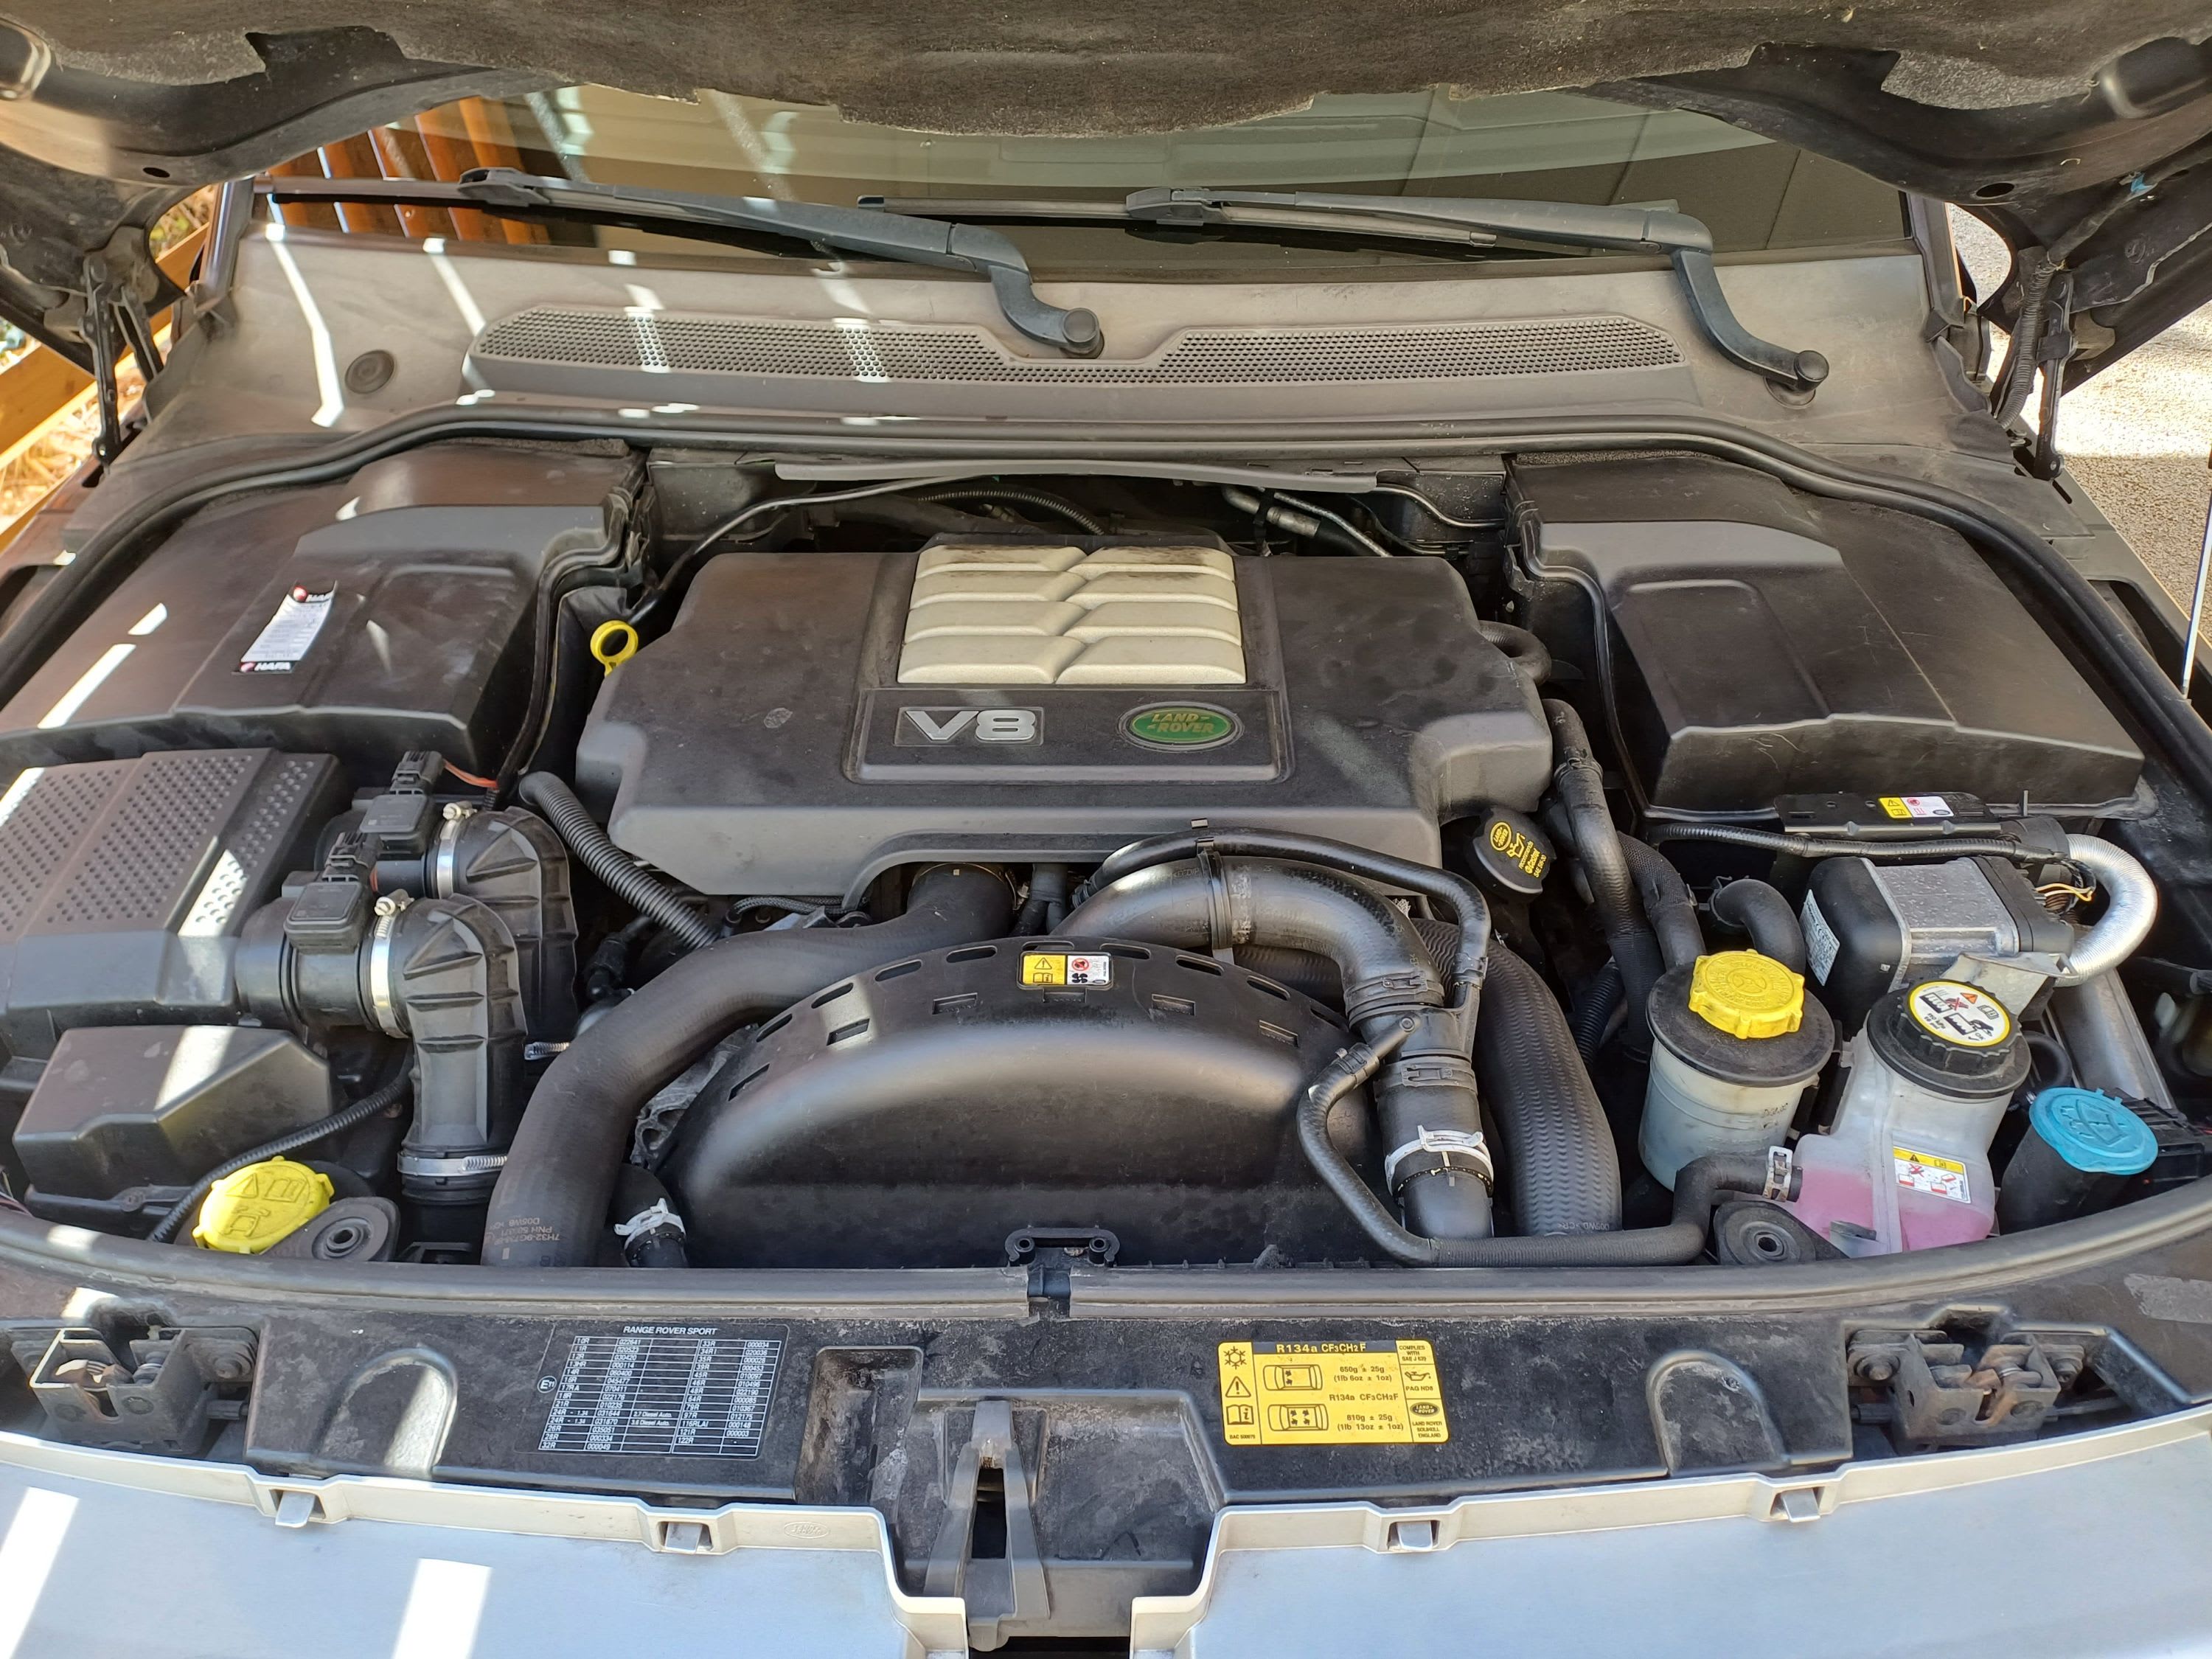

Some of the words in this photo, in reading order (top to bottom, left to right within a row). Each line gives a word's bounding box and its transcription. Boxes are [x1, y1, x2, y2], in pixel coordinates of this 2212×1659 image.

[1151, 712, 1198, 723] LAND
[905, 710, 1036, 742] V8
[1156, 722, 1215, 734] ROVER
[1518, 841, 1534, 869] recommends
[1527, 848, 1540, 870] Castrol
[1534, 867, 1542, 878] SAE
[1975, 1032, 1984, 1040] OK
[623, 1326, 655, 1335] RANGE
[655, 1326, 686, 1335] ROVER
[686, 1327, 717, 1336] SPORT
[1276, 1343, 1318, 1353] R134a
[1371, 1366, 1385, 1374] 25g
[1334, 1374, 1348, 1382] (1lb
[1377, 1374, 1392, 1382] 1oz)
[1338, 1423, 1352, 1431] (1lb
